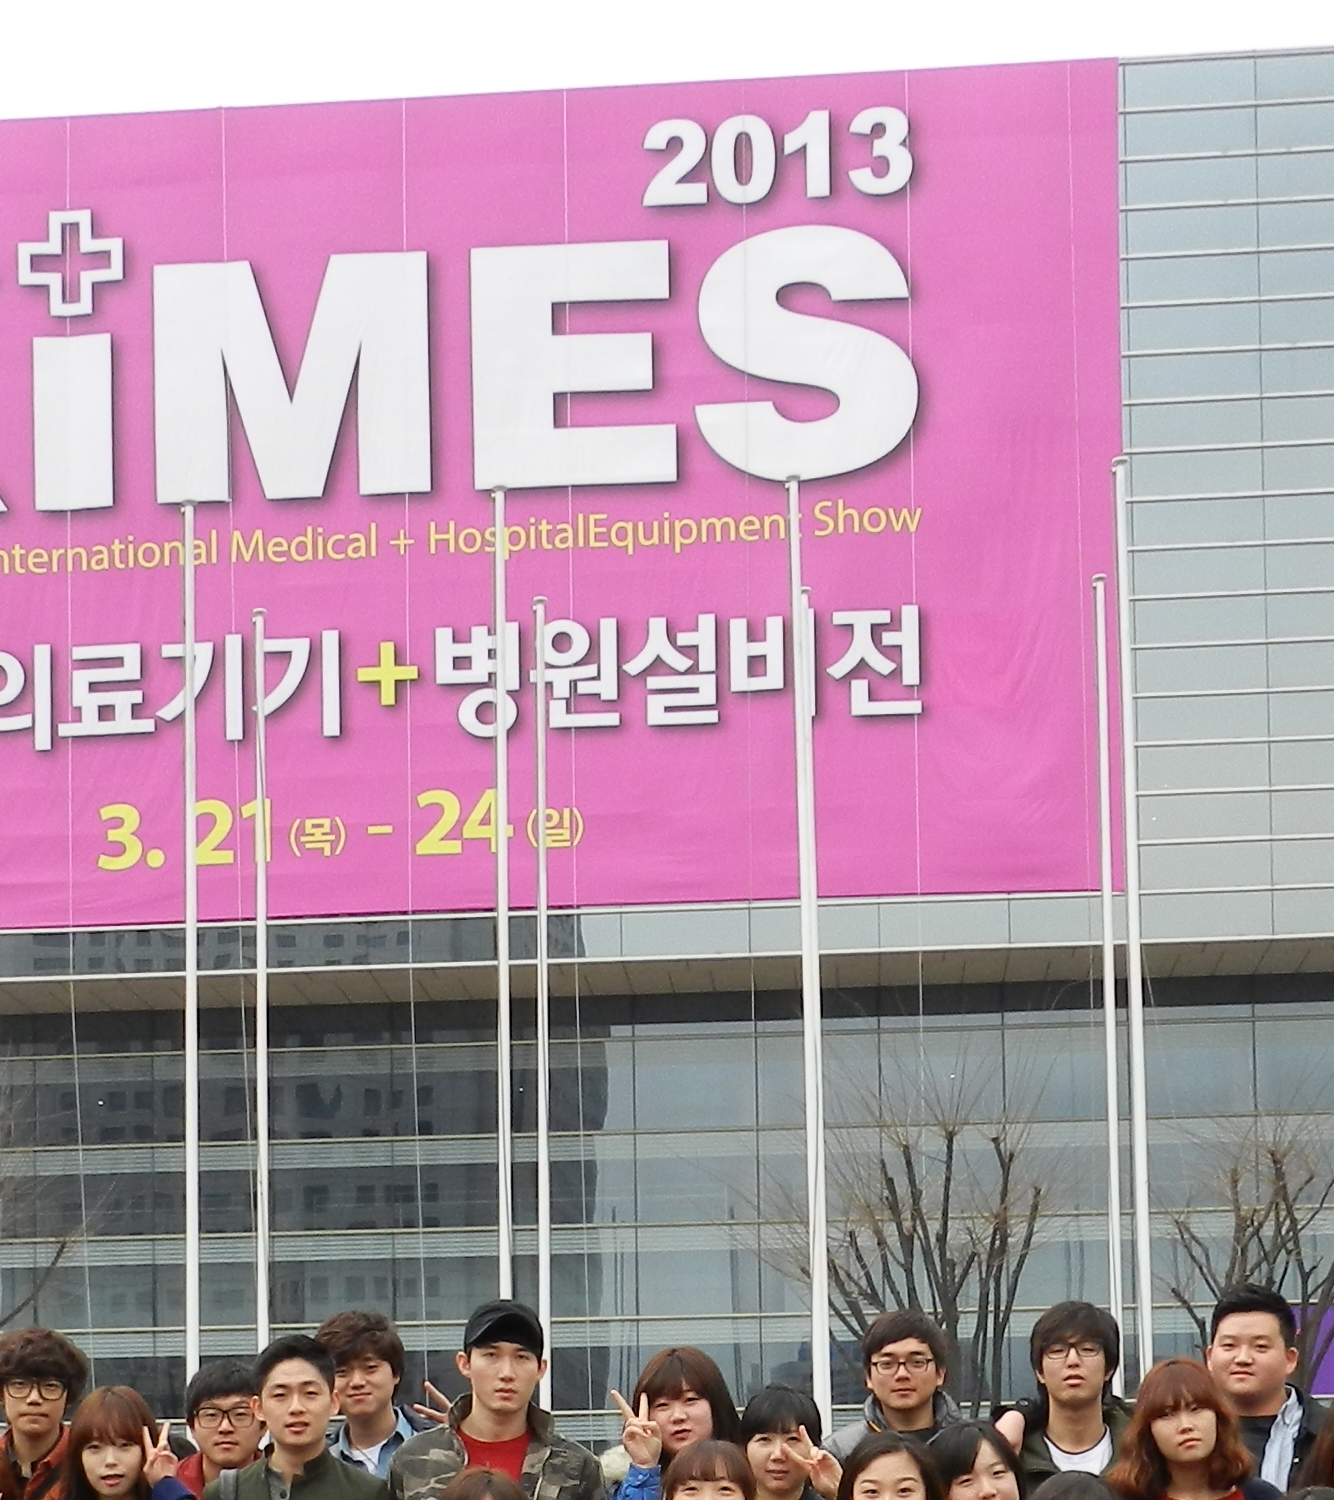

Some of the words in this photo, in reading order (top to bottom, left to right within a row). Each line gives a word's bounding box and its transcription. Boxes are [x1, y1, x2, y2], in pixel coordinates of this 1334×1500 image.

[642, 106, 915, 207] 2013
[230, 522, 377, 564] Medical
[813, 499, 923, 537] Show
[193, 797, 272, 866] 21
[414, 788, 514, 856] 24
